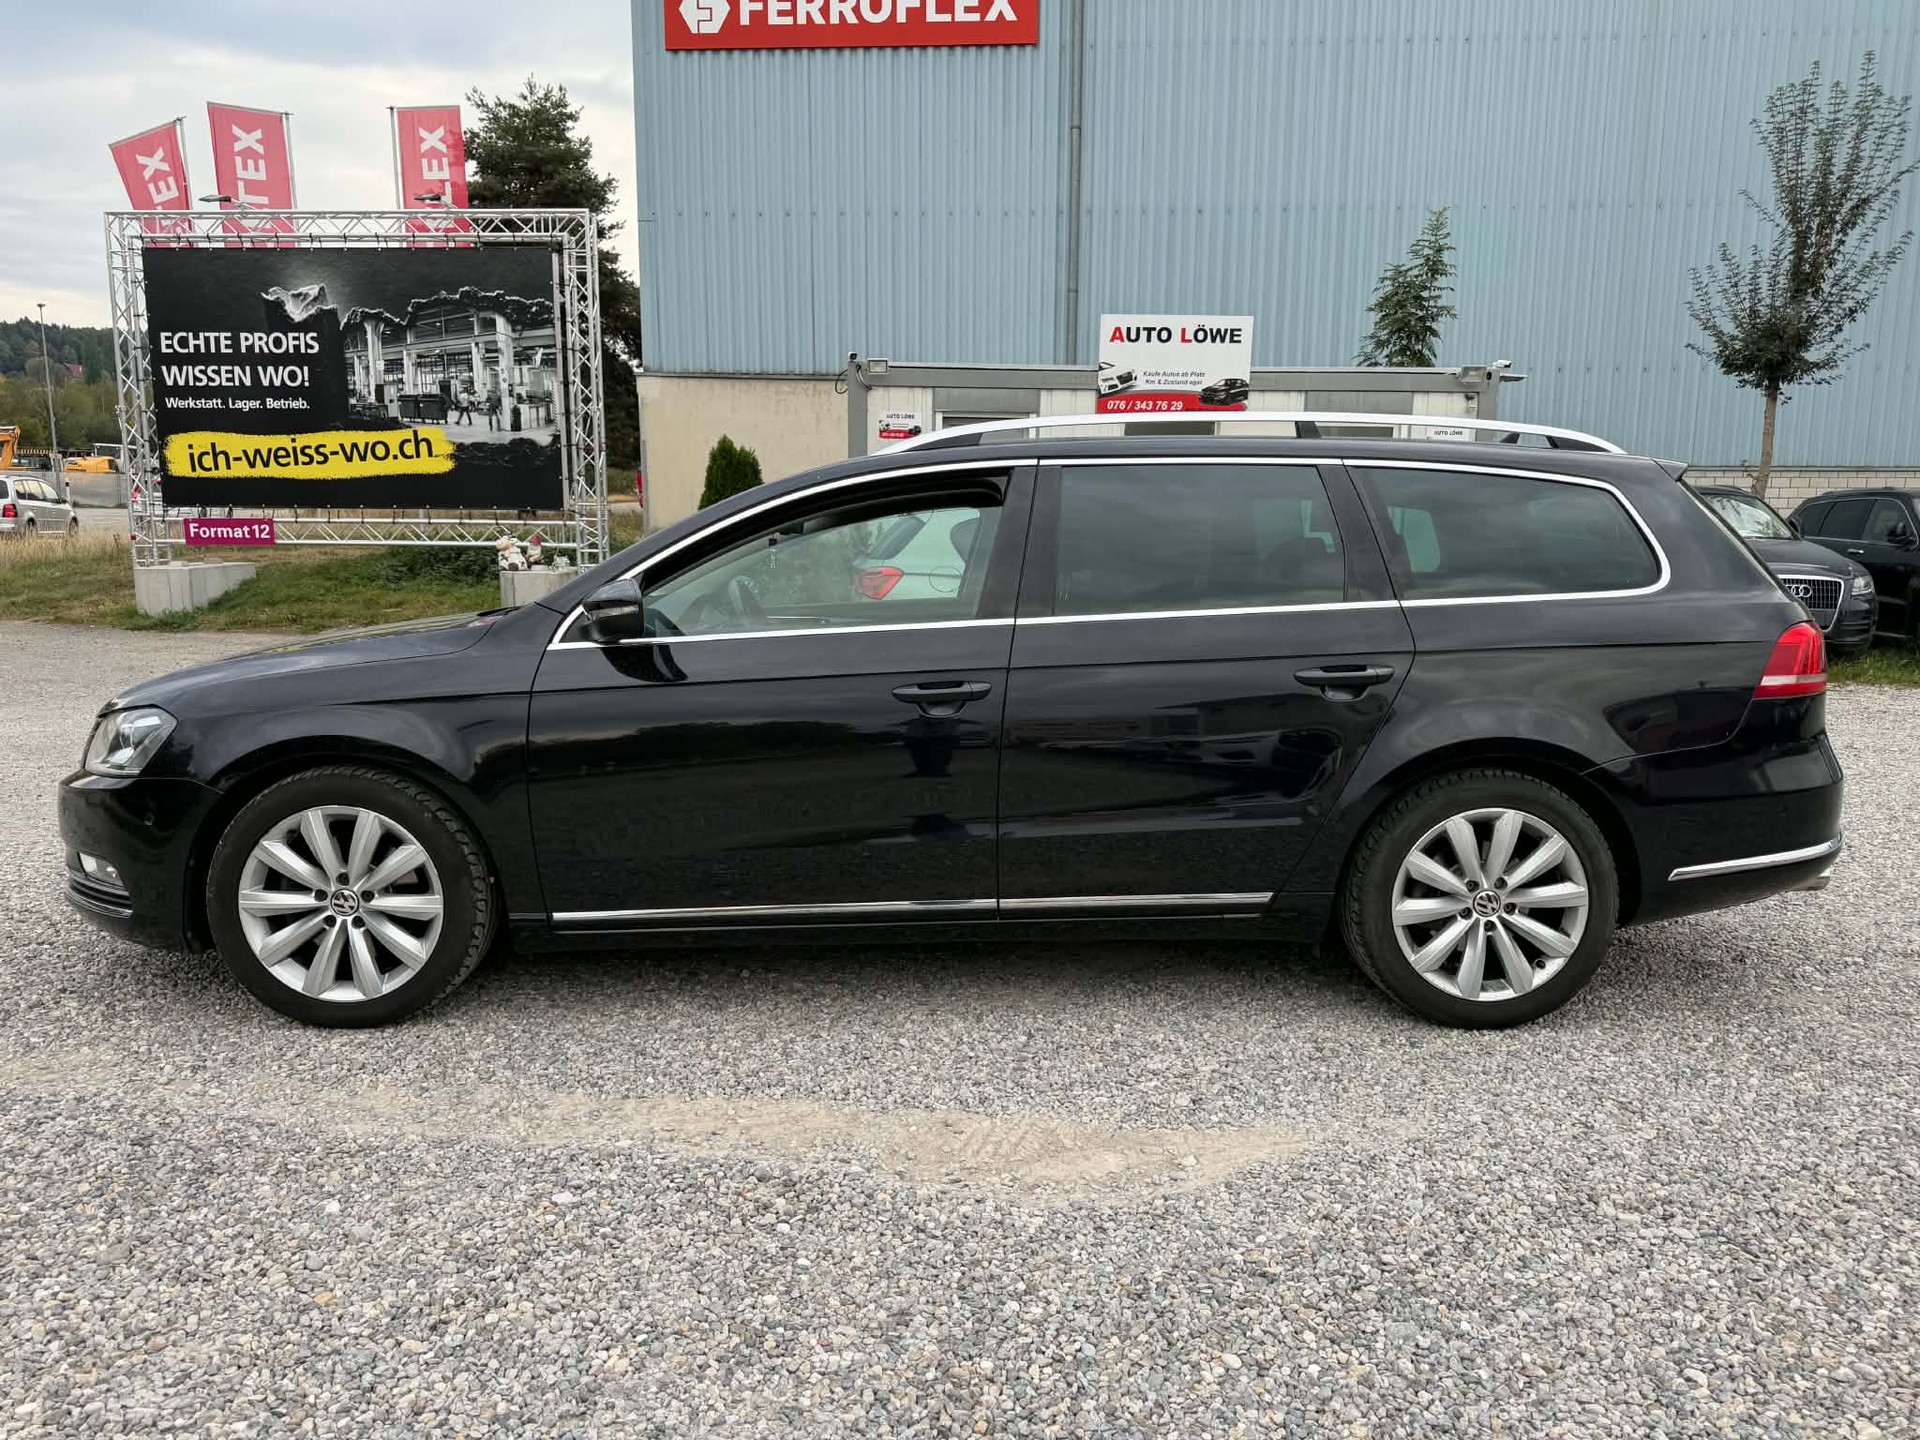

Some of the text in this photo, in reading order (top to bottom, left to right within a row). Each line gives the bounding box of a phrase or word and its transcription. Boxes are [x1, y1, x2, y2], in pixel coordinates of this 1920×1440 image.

[739, 0, 1018, 26] FERROFLEX
[160, 332, 320, 354] ECHTE PROFIS
[1109, 324, 1242, 344] AUTO LÖWE
[161, 365, 310, 387] WISSEN WO!
[1190, 370, 1206, 378] Platz
[165, 397, 310, 412] Werkstatt. Lager. Betrieb.
[1107, 401, 1126, 410] 076
[1134, 401, 1153, 411] 343
[1155, 401, 1168, 411] 76
[1170, 401, 1184, 411] 29
[188, 429, 434, 473] ich-weiss-wo.ch
[189, 522, 271, 540] Format 12
